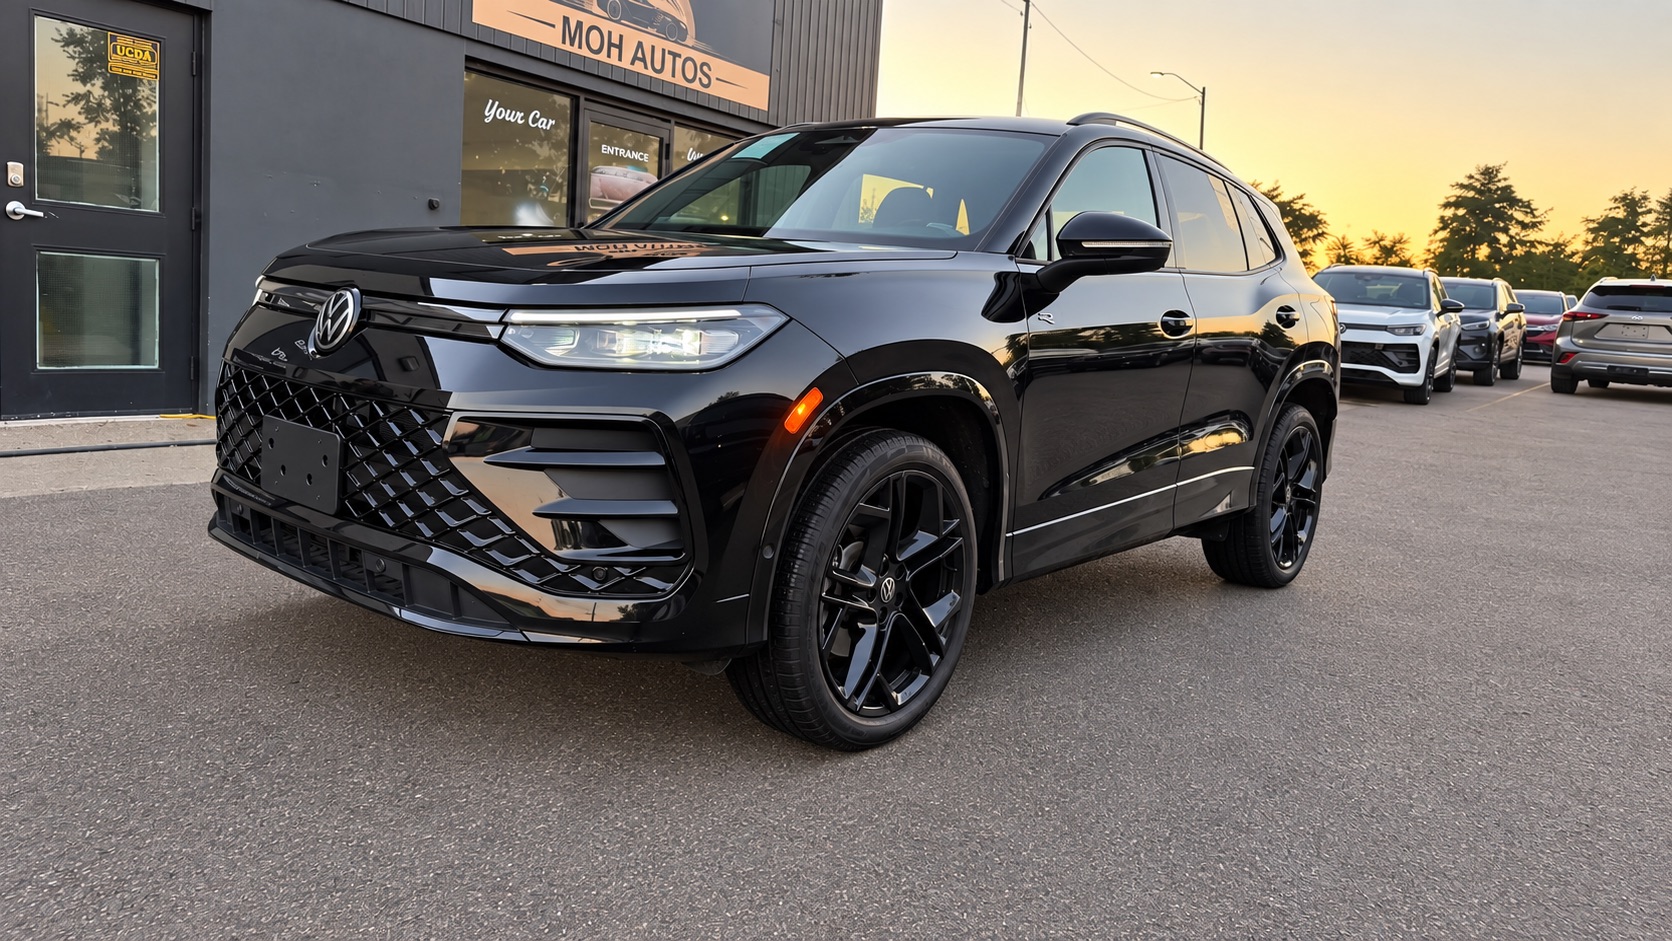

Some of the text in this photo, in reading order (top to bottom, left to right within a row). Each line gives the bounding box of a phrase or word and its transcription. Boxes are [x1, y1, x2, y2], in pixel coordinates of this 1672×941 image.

[116, 45, 152, 62] UCDA
[561, 15, 712, 89] MOH AUTOS
[484, 98, 556, 131] Your Car
[601, 144, 649, 162] ENTRANCE
